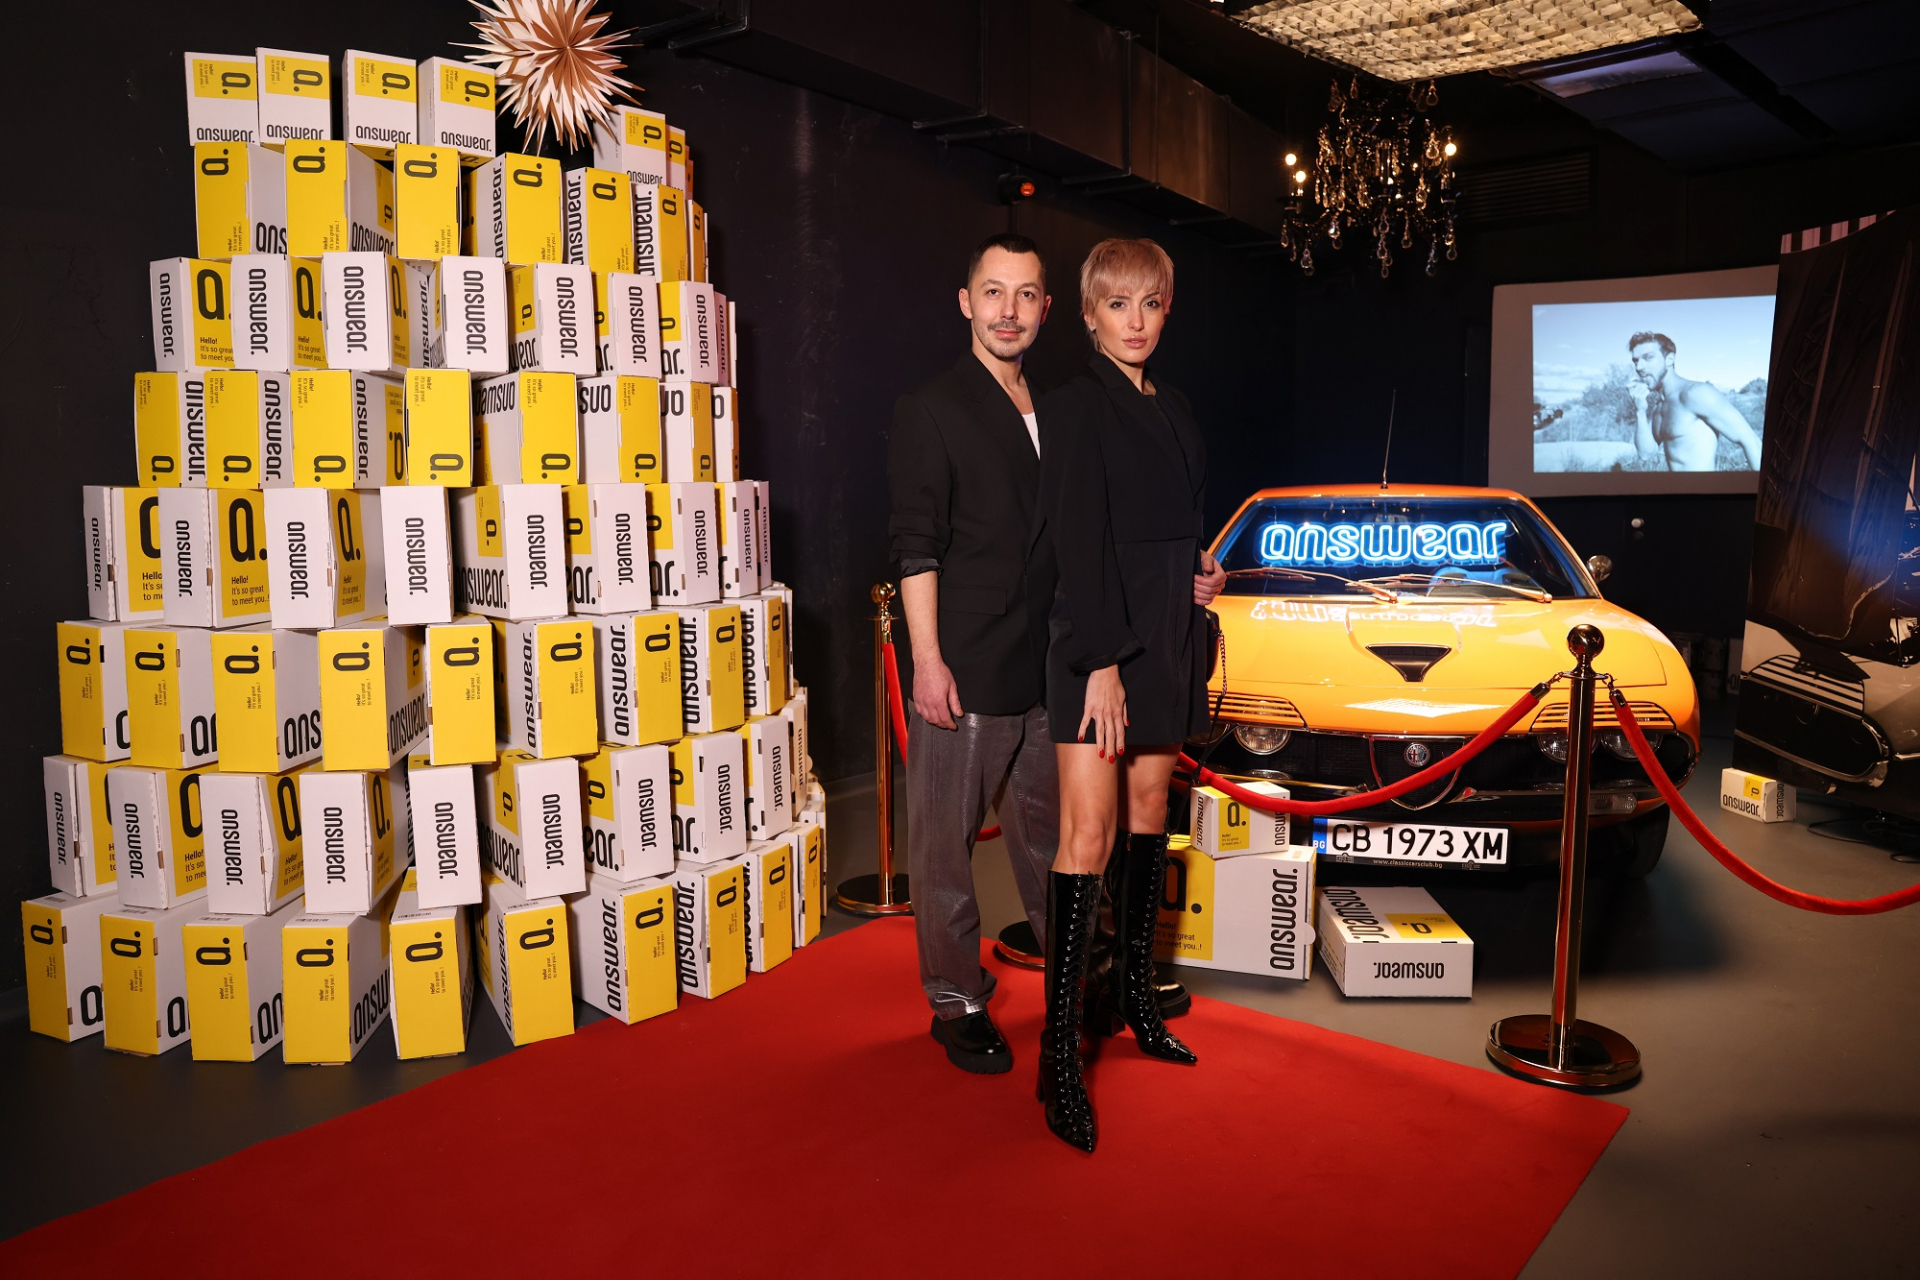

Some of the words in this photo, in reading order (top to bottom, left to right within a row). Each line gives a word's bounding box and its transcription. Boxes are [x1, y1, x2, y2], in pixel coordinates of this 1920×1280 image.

[221, 72, 251, 95] a.
[293, 69, 324, 92] a.
[382, 72, 411, 95] a.
[464, 80, 491, 102] a.
[196, 127, 255, 143] answear.
[266, 124, 324, 140] answear
[441, 131, 492, 152] answear.
[643, 125, 662, 144] a.
[201, 148, 229, 176] a.
[293, 146, 326, 174] a.
[669, 140, 683, 158] a.
[404, 152, 438, 179] a.
[513, 163, 543, 188] a.
[627, 170, 663, 185] answear
[592, 177, 617, 201] a.
[493, 161, 504, 258] answear.
[662, 193, 677, 216] a.
[295, 266, 323, 322] a.
[391, 264, 407, 320] a.
[159, 272, 175, 358] answear.
[248, 268, 269, 356] answear.
[343, 265, 368, 354] answear.
[463, 270, 487, 355] answear.
[521, 303, 533, 326] a.
[556, 276, 579, 359] answear.
[297, 335, 310, 343] Hello!
[628, 285, 648, 364] answear.
[695, 294, 710, 369] answear.
[199, 336, 218, 345] Hello!
[200, 345, 210, 353] It's
[219, 346, 234, 355] grea
[208, 353, 224, 361] meet
[264, 379, 282, 482] answear.
[355, 378, 369, 481] answear.
[151, 455, 175, 482] a.
[223, 455, 252, 482] a.
[313, 455, 347, 483] a.
[389, 431, 404, 481] a.
[430, 453, 464, 481] a.
[541, 453, 571, 479] a.
[634, 453, 657, 478] a.
[700, 454, 711, 478] a.
[228, 497, 268, 563] a.
[337, 497, 361, 562] a.
[485, 519, 497, 546] a.
[694, 510, 708, 578] answear.
[743, 508, 753, 573] answear.
[1260, 522, 1507, 562] answear
[91, 517, 102, 592] answear.
[175, 520, 193, 598] answear.
[287, 521, 309, 600] answear.
[404, 517, 428, 596] answear.
[526, 514, 548, 590] answear.
[615, 512, 634, 586] answear.
[142, 572, 163, 580] Hello
[143, 582, 155, 590] It's
[231, 575, 249, 585] Hello!
[231, 586, 241, 595] It's
[249, 585, 264, 595] great
[239, 596, 254, 605] meet
[715, 616, 736, 644] a.
[771, 606, 781, 632] a.
[66, 637, 91, 665] a.
[443, 637, 480, 667] a.
[550, 632, 583, 663] a.
[645, 623, 671, 653] a.
[134, 642, 165, 672] a.
[224, 645, 260, 674] a.
[333, 641, 371, 672] a.
[412, 648, 420, 676] a.
[679, 616, 701, 725] answear.
[522, 632, 537, 749] answear.
[610, 624, 630, 737] answear.
[587, 779, 606, 806] a.
[772, 745, 784, 812] answear.
[372, 774, 391, 840] a.
[502, 791, 513, 817] a.
[717, 764, 733, 835] answear.
[1722, 794, 1761, 818] answear.
[1776, 783, 1785, 819] answear.
[53, 791, 67, 866] answear.
[638, 778, 657, 852] answear.
[1196, 796, 1204, 847] answear.
[1227, 802, 1247, 827] a.
[124, 803, 144, 879] answear.
[323, 806, 346, 885] answear.
[434, 801, 459, 880] answear.
[541, 793, 565, 870] answear.
[1312, 839, 1326, 849] BG
[1332, 823, 1372, 853] CB
[1382, 826, 1455, 858] 1973
[1461, 830, 1504, 860] XM
[184, 849, 204, 862] Hello!
[220, 808, 244, 886] answear.
[285, 852, 298, 865] Hello!
[808, 836, 818, 864] a.
[185, 863, 195, 872] It's
[196, 861, 204, 869] so
[186, 875, 193, 883] to
[769, 856, 786, 886] a.
[716, 876, 737, 908] a.
[635, 897, 664, 930] a.
[1269, 868, 1298, 971] answear.
[1321, 888, 1390, 940] answear.
[1401, 922, 1433, 934] a.
[30, 918, 54, 946] a.
[110, 930, 142, 958] a.
[519, 918, 555, 951] a.
[676, 880, 699, 988] answear.
[1177, 932, 1195, 941] great
[1183, 942, 1202, 951] you..!
[195, 937, 232, 966] a.
[296, 938, 334, 968] a.
[405, 931, 443, 963] a.
[602, 898, 622, 1012] answear.
[497, 914, 512, 1032] answear.
[1373, 961, 1445, 980] answear.
